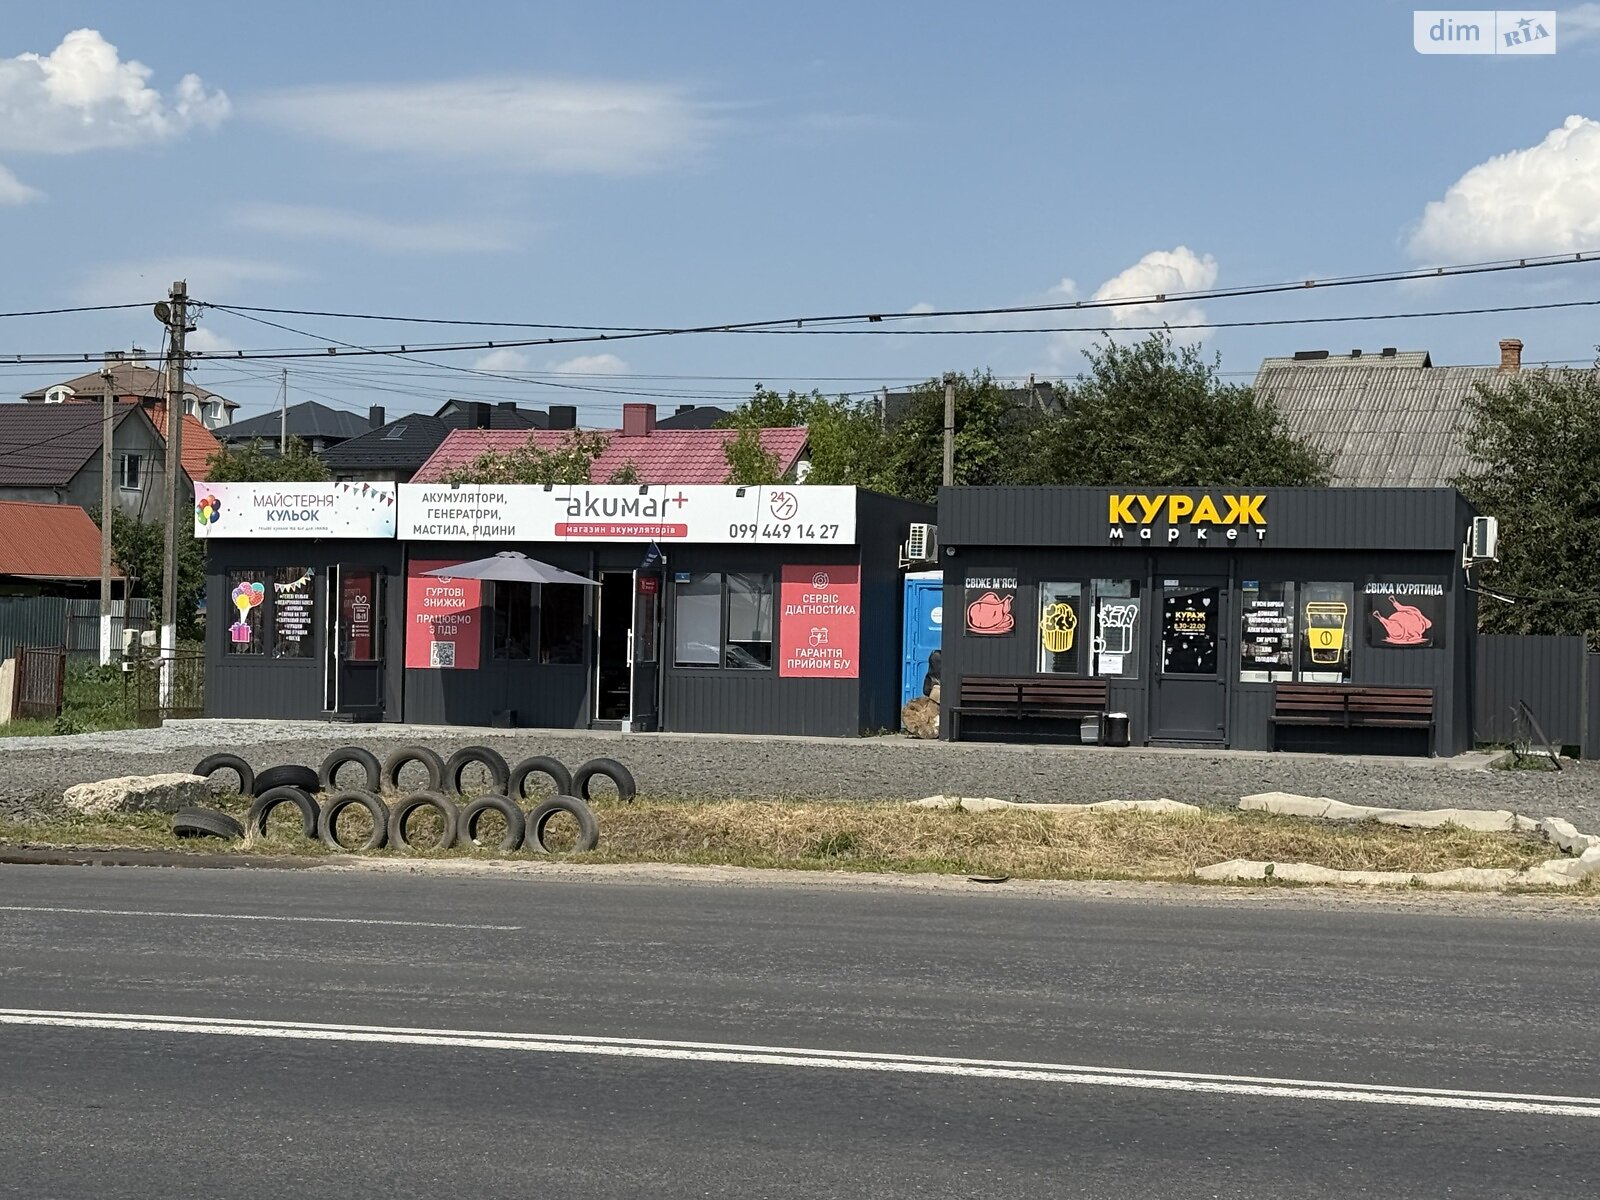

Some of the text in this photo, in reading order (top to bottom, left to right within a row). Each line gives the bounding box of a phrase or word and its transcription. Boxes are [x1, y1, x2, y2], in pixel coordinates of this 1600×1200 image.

[254, 492, 334, 508] МАЙСТЕРНЯ
[422, 493, 508, 504] АКУМУЛЯТОРИ,
[427, 509, 502, 520] ГЕНЕРАТОРИ,
[1109, 495, 1268, 524] КУРАЖ
[266, 510, 320, 522] КУЛЬОК
[413, 525, 516, 536] МАСТИЛА, РІДИНИ
[610, 526, 676, 534] акумуляторів
[729, 524, 839, 538] 099 449 14 27
[1109, 528, 1266, 542] маркет
[966, 578, 992, 588] СВІЖЕ
[426, 588, 464, 597] ГУРТОВІ
[1365, 583, 1444, 596] СВІЖА КУРЯТИНА
[424, 598, 466, 607] ЗНИЖКИ
[802, 594, 839, 603] СЕРВІС
[785, 605, 856, 616] ДІАГНОСТИКА
[416, 614, 472, 624] ПРАЦЮЄМО
[429, 626, 458, 636] З ПДВ
[796, 648, 842, 658] ГАРАНТІЯ
[788, 658, 850, 669] ПРИЙОМ Б/У
